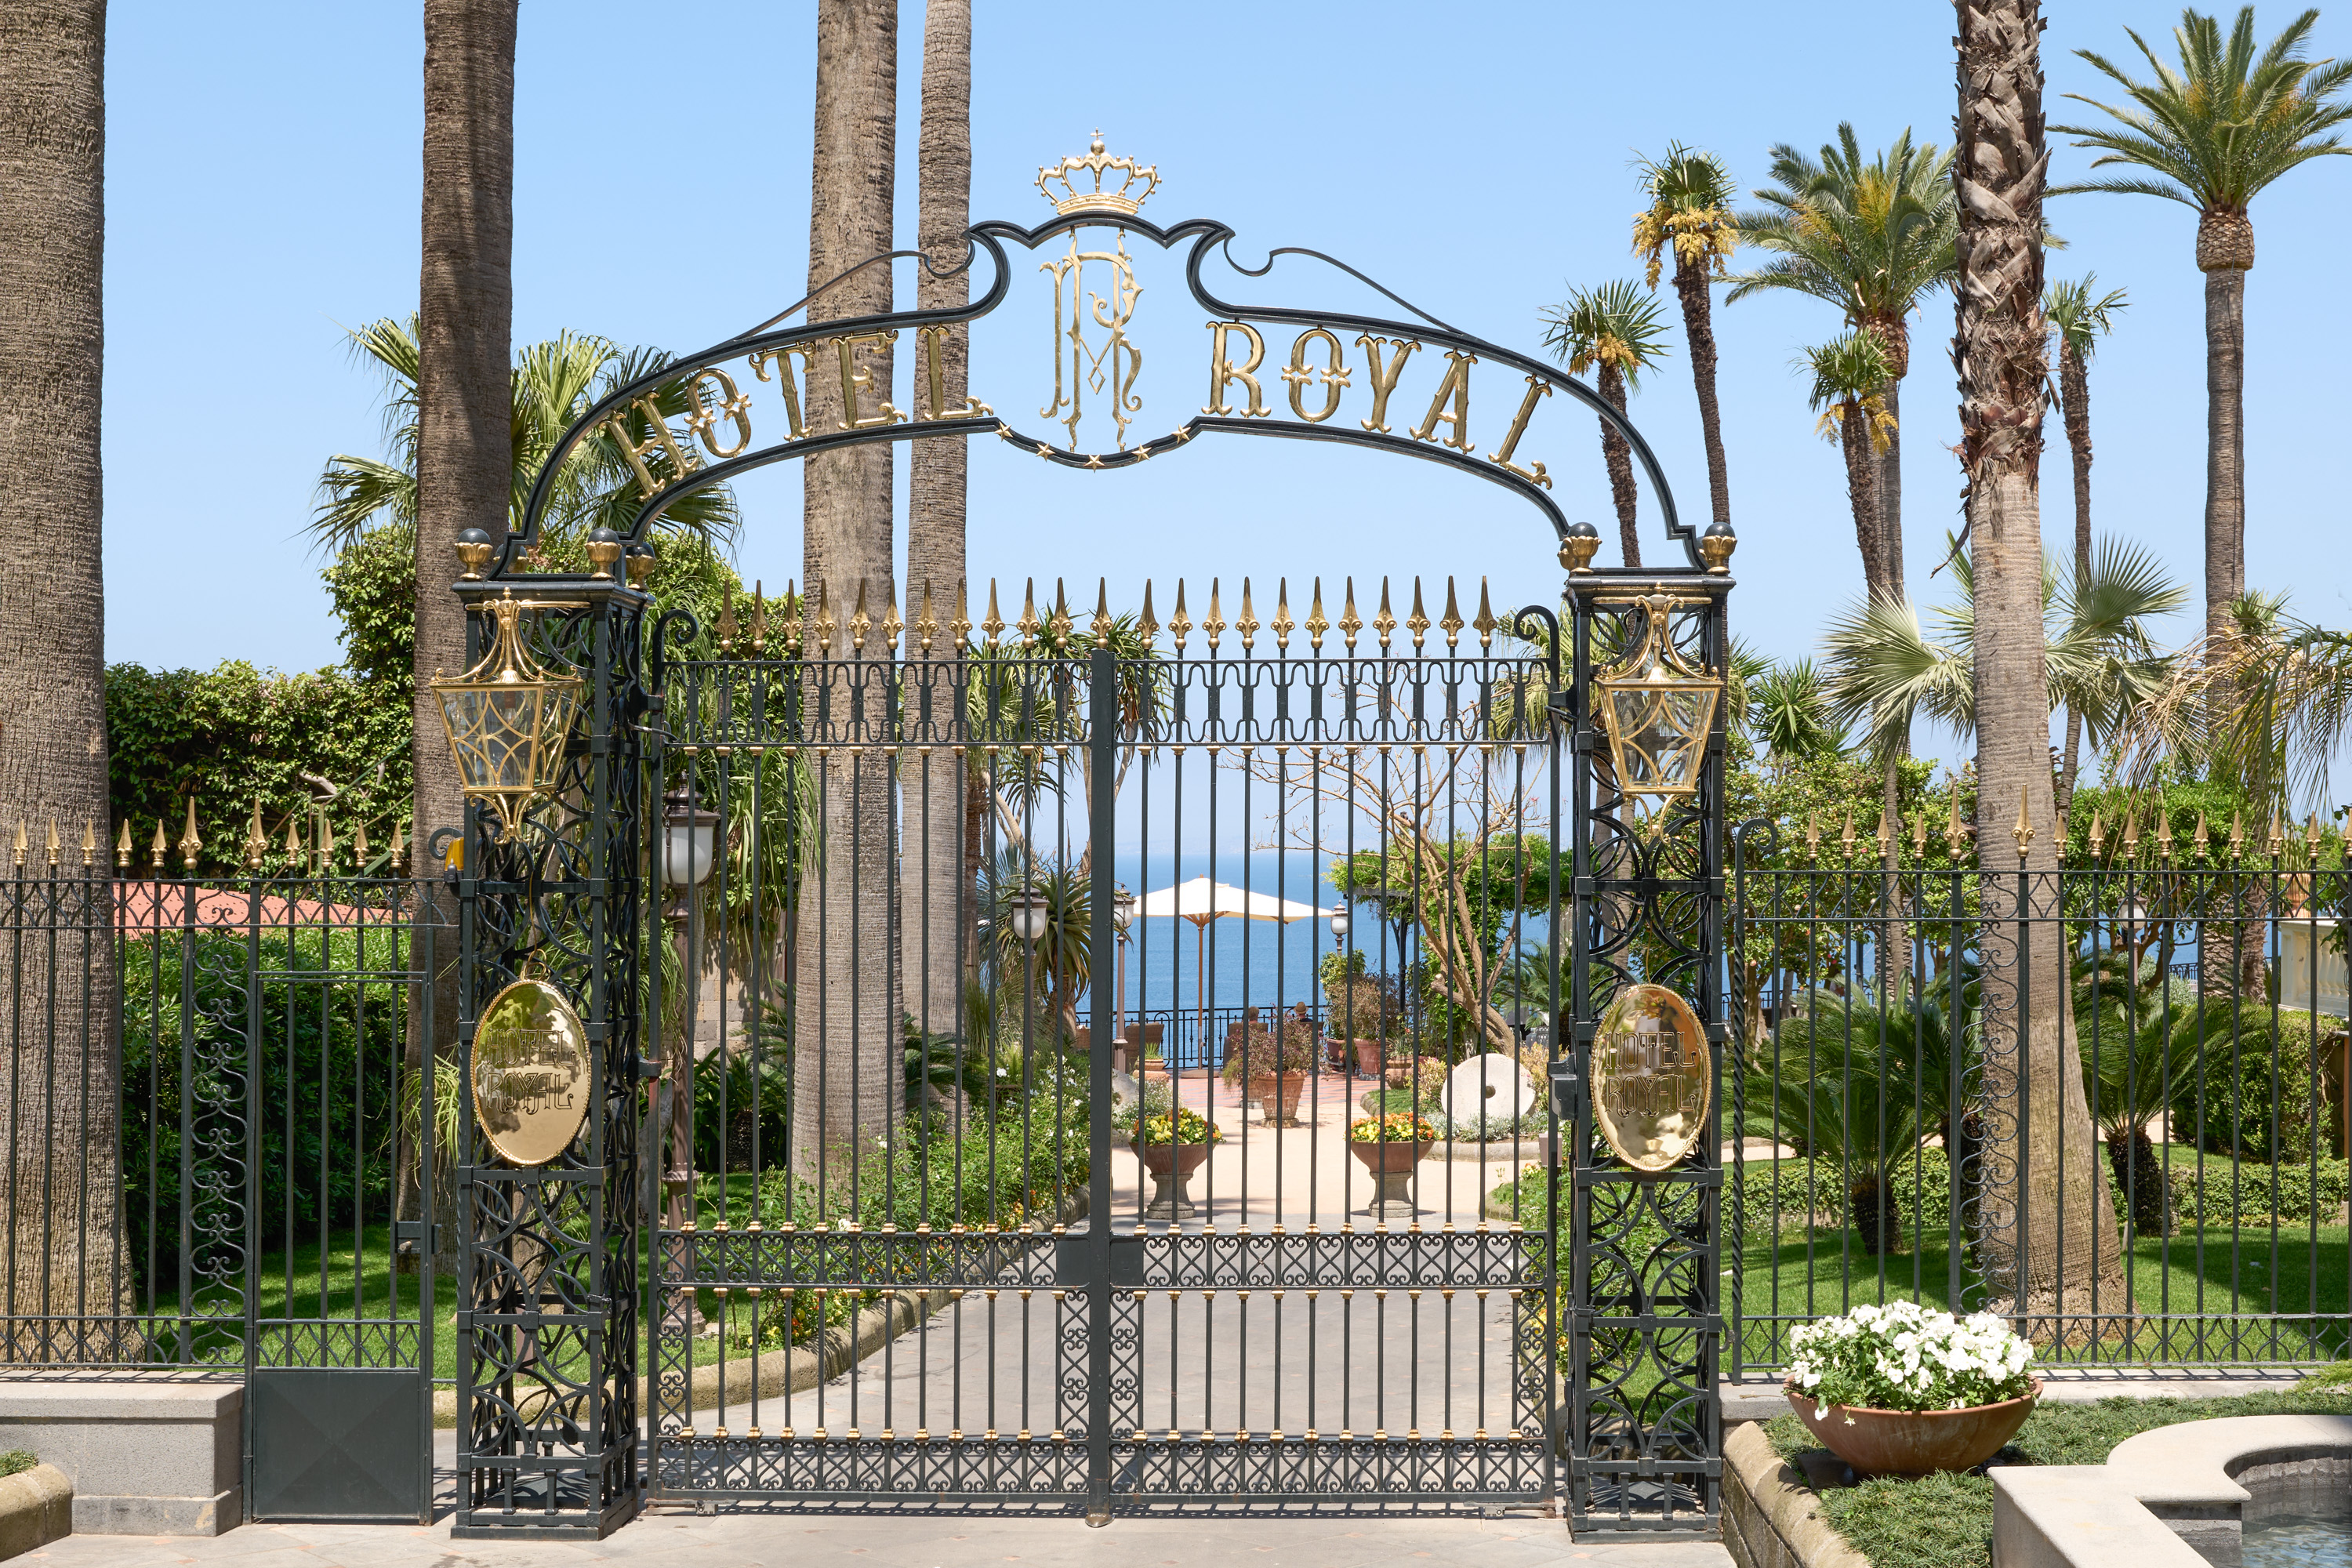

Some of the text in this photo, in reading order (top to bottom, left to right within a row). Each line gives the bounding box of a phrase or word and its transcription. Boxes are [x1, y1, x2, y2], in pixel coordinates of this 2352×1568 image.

[598, 320, 1555, 502] HOTEL ROYAL
[486, 1028, 576, 1067] HOTEL
[1604, 1031, 1697, 1070] HOTEL
[485, 1072, 575, 1115] ROYAL
[1604, 1074, 1697, 1118] ROYAL
